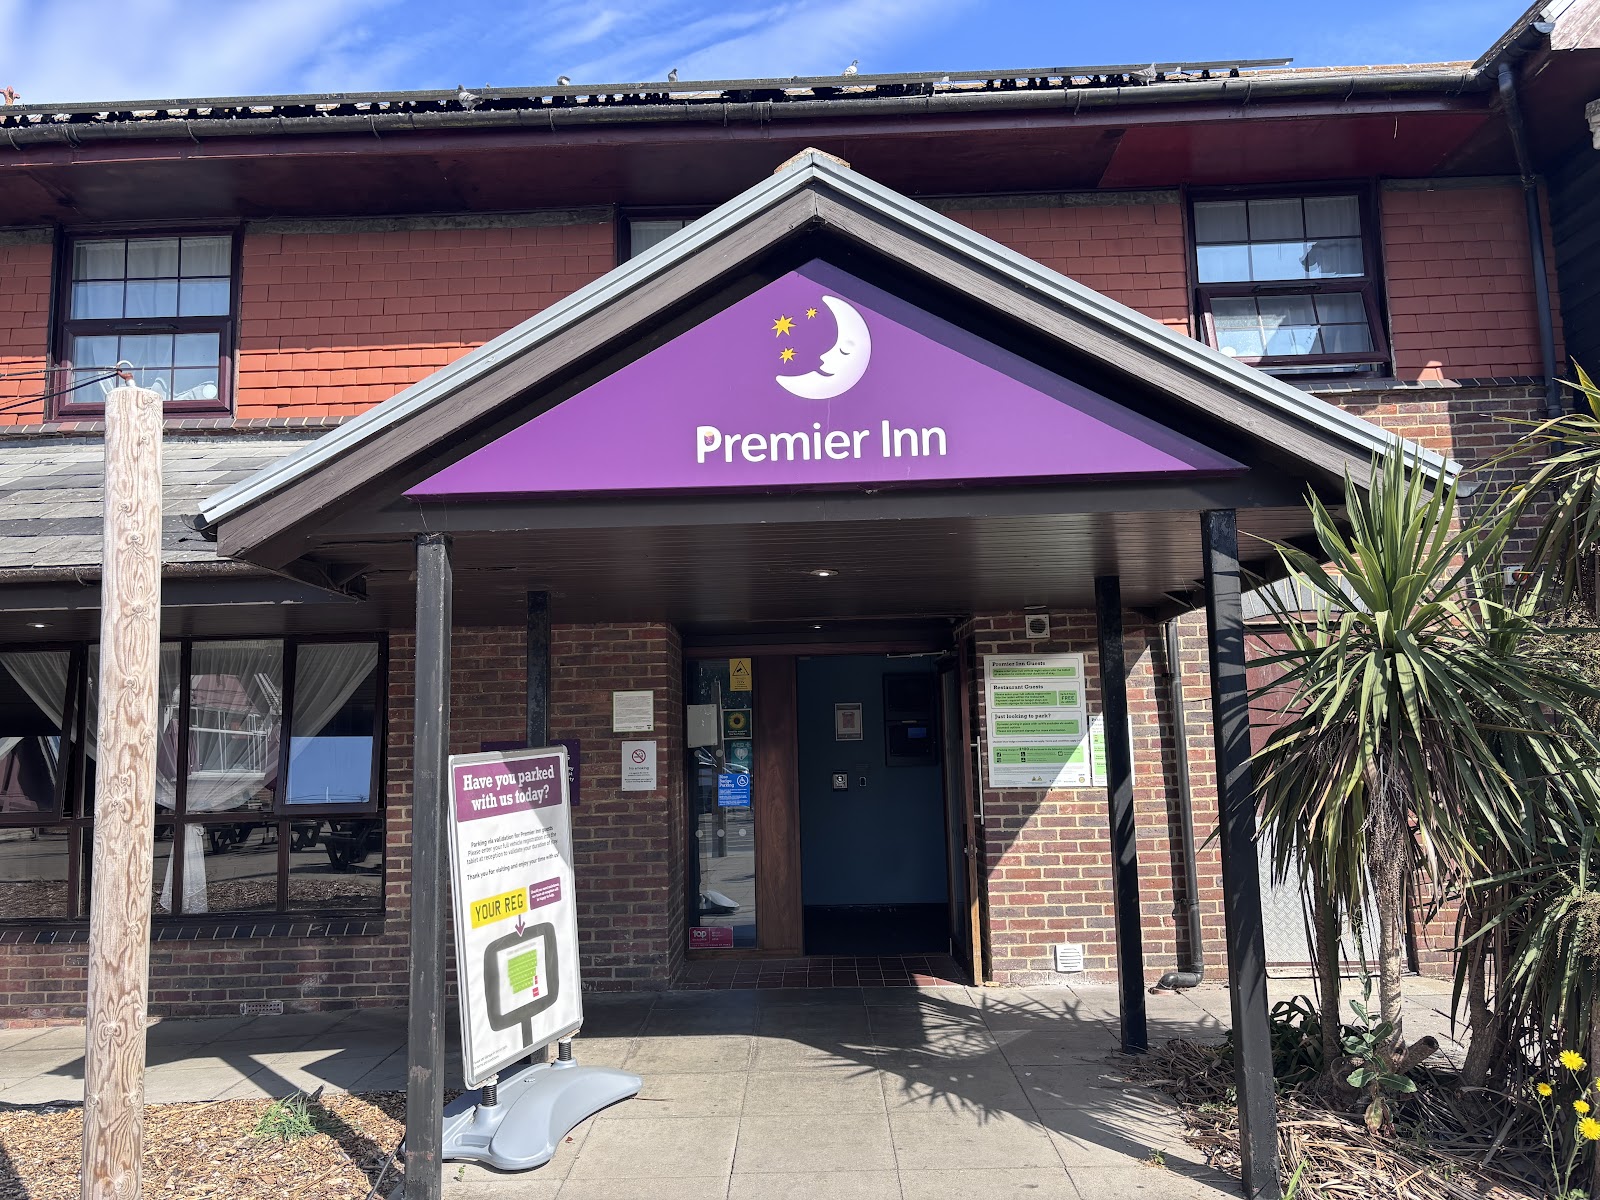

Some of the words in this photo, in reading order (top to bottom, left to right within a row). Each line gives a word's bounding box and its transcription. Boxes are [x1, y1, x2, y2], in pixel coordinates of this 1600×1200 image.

[696, 422, 870, 464] Premier
[882, 419, 947, 458] Inn
[463, 774, 493, 791] Have
[495, 774, 516, 790] you
[518, 765, 555, 784] parked
[472, 793, 498, 811] with
[499, 795, 514, 806] us
[515, 784, 550, 804] today?
[468, 849, 481, 857] Please
[510, 839, 522, 847] vehicle
[471, 840, 487, 848] Parking
[495, 834, 514, 843] validation
[484, 852, 504, 860] reception
[467, 872, 480, 880] Thank
[481, 871, 489, 879] you
[496, 865, 511, 873] visiting
[519, 860, 529, 868] enjoy
[529, 858, 538, 866] your
[476, 900, 501, 922] YOUR
[505, 893, 524, 913] REG
[693, 930, 707, 938] top
